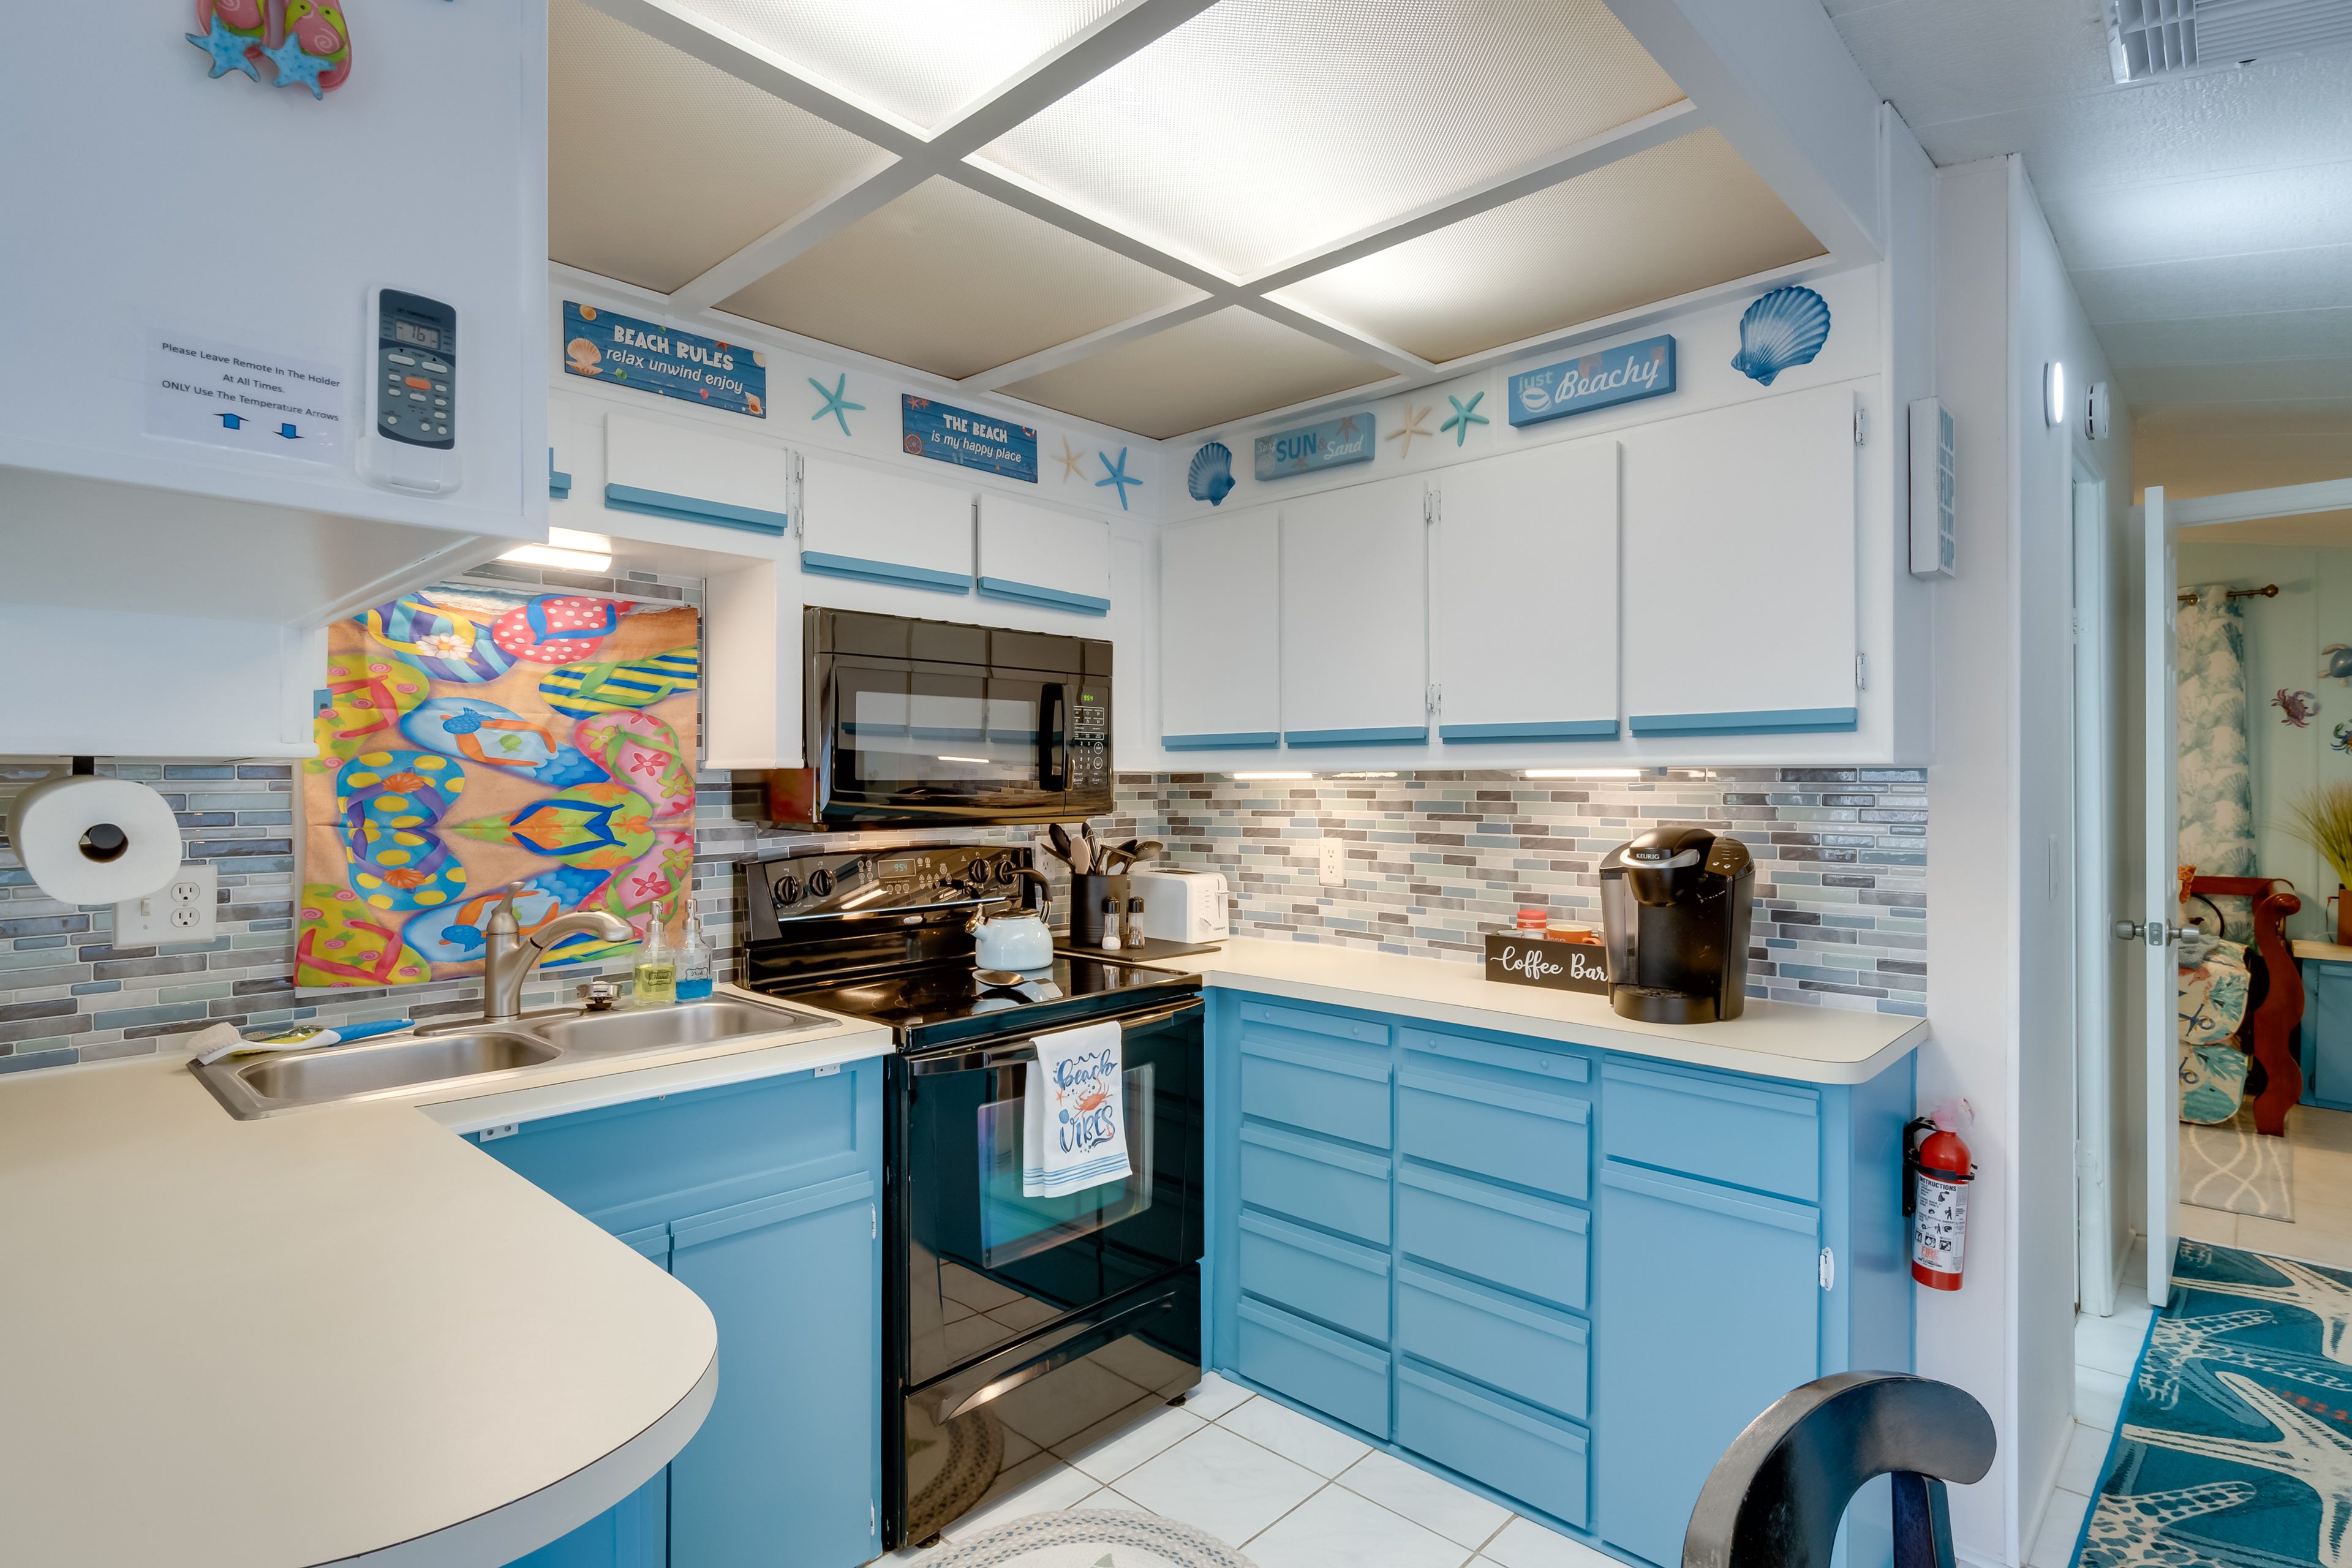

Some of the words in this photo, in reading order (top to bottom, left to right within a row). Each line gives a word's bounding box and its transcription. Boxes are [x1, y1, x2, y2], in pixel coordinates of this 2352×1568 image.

[162, 342, 197, 356] Please
[200, 351, 230, 364] Leave
[233, 358, 273, 373] Remote
[276, 367, 284, 375] In
[288, 369, 305, 380] The
[308, 374, 341, 387] Holder
[614, 325, 671, 354] BEACH
[676, 341, 734, 371] RULES
[222, 374, 234, 383] At
[237, 377, 250, 386] All
[253, 380, 285, 393] Times.
[606, 348, 644, 369] relax
[649, 360, 702, 382] unwind
[705, 374, 744, 394] enjoy
[1517, 371, 1553, 393] just
[1555, 356, 1660, 404] Beachy
[162, 380, 190, 392] ONLY
[194, 386, 214, 397] Use
[217, 390, 236, 401] The
[239, 394, 303, 415] Temperature
[305, 409, 339, 421] Arrows
[931, 430, 940, 442] is
[944, 435, 959, 449] my
[963, 439, 993, 458] happy
[995, 448, 1022, 463] place
[943, 413, 969, 433] THE
[973, 421, 1008, 443] BEACH
[1276, 432, 1317, 462] SUN
[1324, 434, 1365, 460] Sand
[1939, 406, 1954, 452] YOU
[1490, 946, 1563, 980] Coffee
[1570, 953, 1608, 982] Bar
[1060, 1105, 1115, 1153] VIBES
[1919, 1175, 1957, 1191] INSTRUCTIONS
